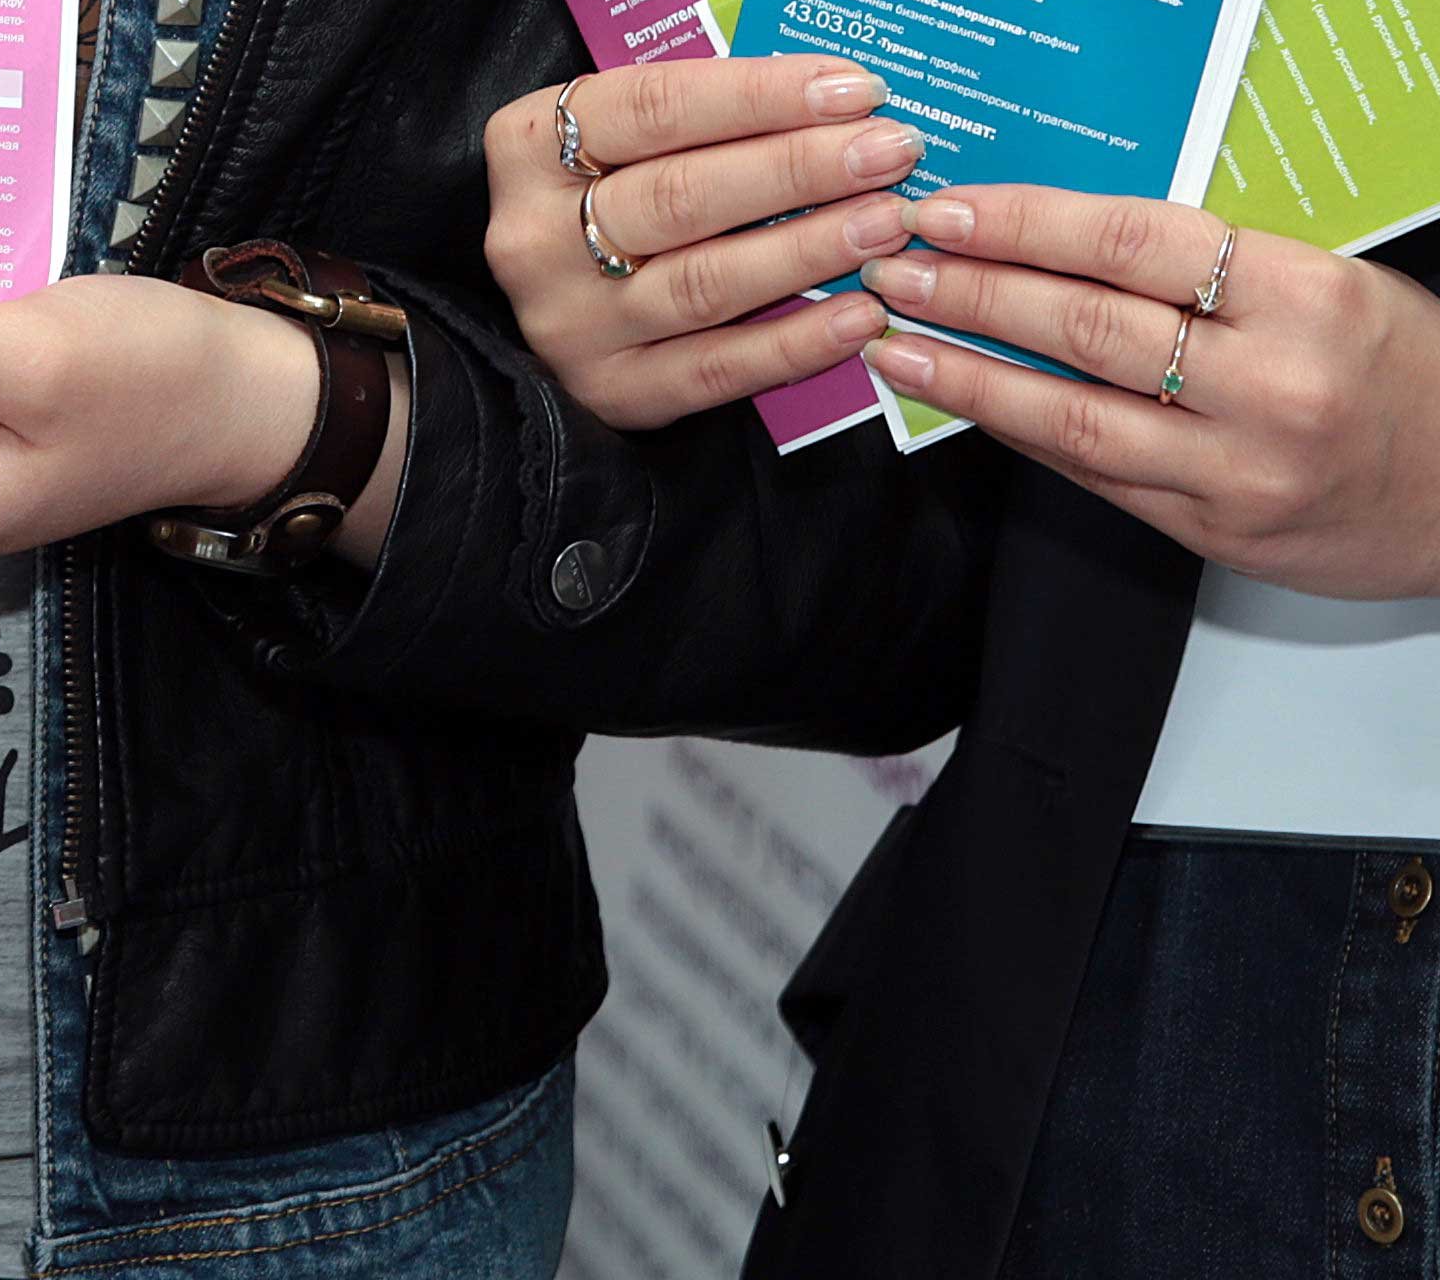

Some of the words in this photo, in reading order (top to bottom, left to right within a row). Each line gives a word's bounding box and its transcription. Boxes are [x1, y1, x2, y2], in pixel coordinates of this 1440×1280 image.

[782, 0, 876, 44] 43.03.02
[778, 22, 841, 52] Технология
[841, 46, 851, 60] и
[848, 48, 924, 80] организация
[926, 73, 1021, 113] туроператорских
[1021, 106, 1031, 116] и
[1032, 109, 1108, 141] турагентских
[1107, 134, 1139, 151] услуг
